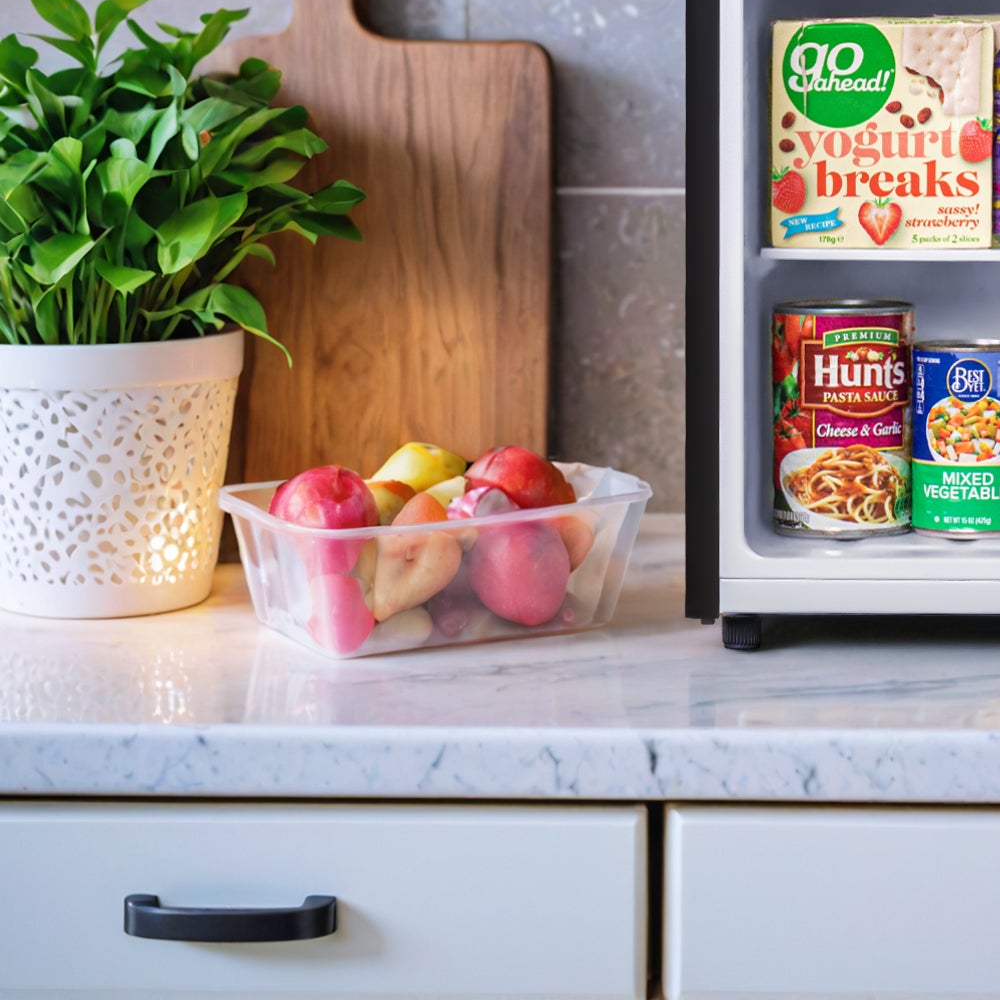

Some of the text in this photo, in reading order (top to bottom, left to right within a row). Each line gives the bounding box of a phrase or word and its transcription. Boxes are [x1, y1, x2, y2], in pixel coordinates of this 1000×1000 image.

[788, 42, 864, 92] go
[814, 70, 890, 92] ahead!
[793, 122, 958, 169] yogurt
[813, 160, 980, 197] breaks
[937, 204, 980, 215] sassy!
[788, 218, 808, 226] NEW
[805, 219, 836, 231] RECIPE
[904, 216, 980, 229] strawberry
[819, 236, 836, 244] 178g
[912, 234, 980, 244] 5 packs of 2 slices
[834, 331, 892, 342] PREMIUM
[967, 382, 985, 393] YET
[823, 390, 898, 403] PASTA SAUCE
[816, 421, 902, 438] Cheese & Garlic
[942, 471, 994, 486] MIXED
